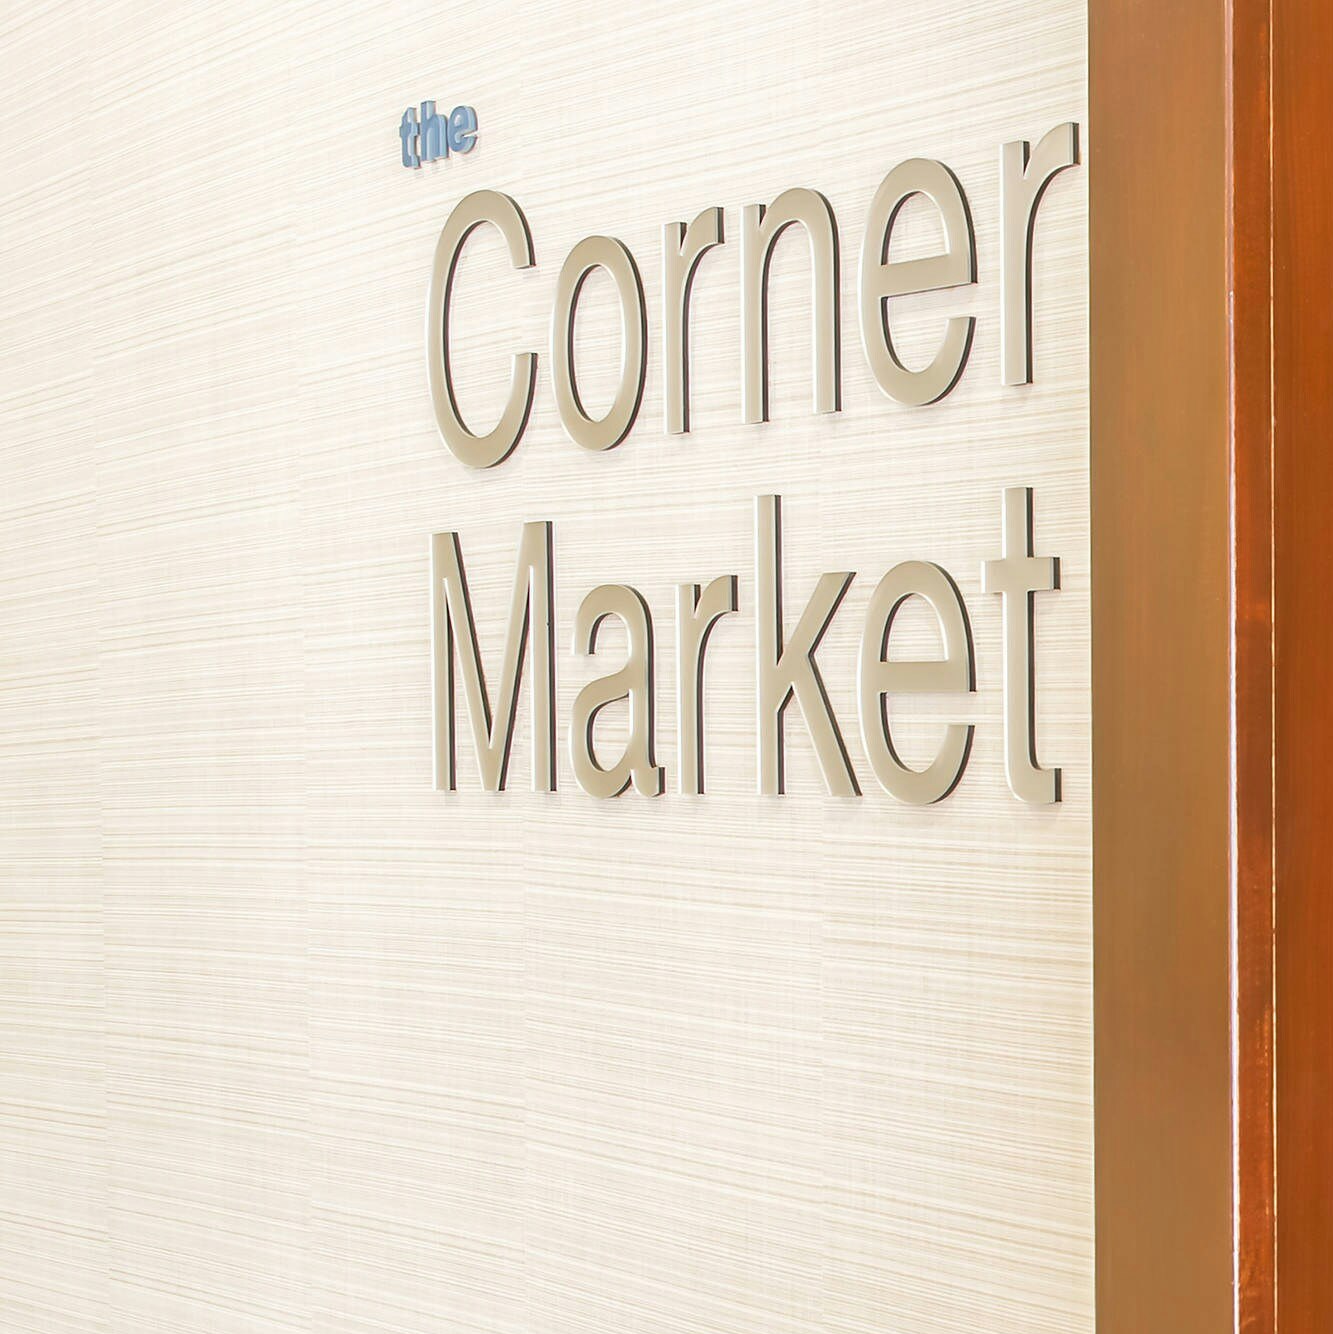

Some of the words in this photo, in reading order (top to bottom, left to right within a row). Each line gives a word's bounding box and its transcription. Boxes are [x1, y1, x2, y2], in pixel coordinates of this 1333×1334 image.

[400, 100, 477, 168] the
[426, 121, 1080, 468] Corner
[431, 486, 1062, 804] Market
